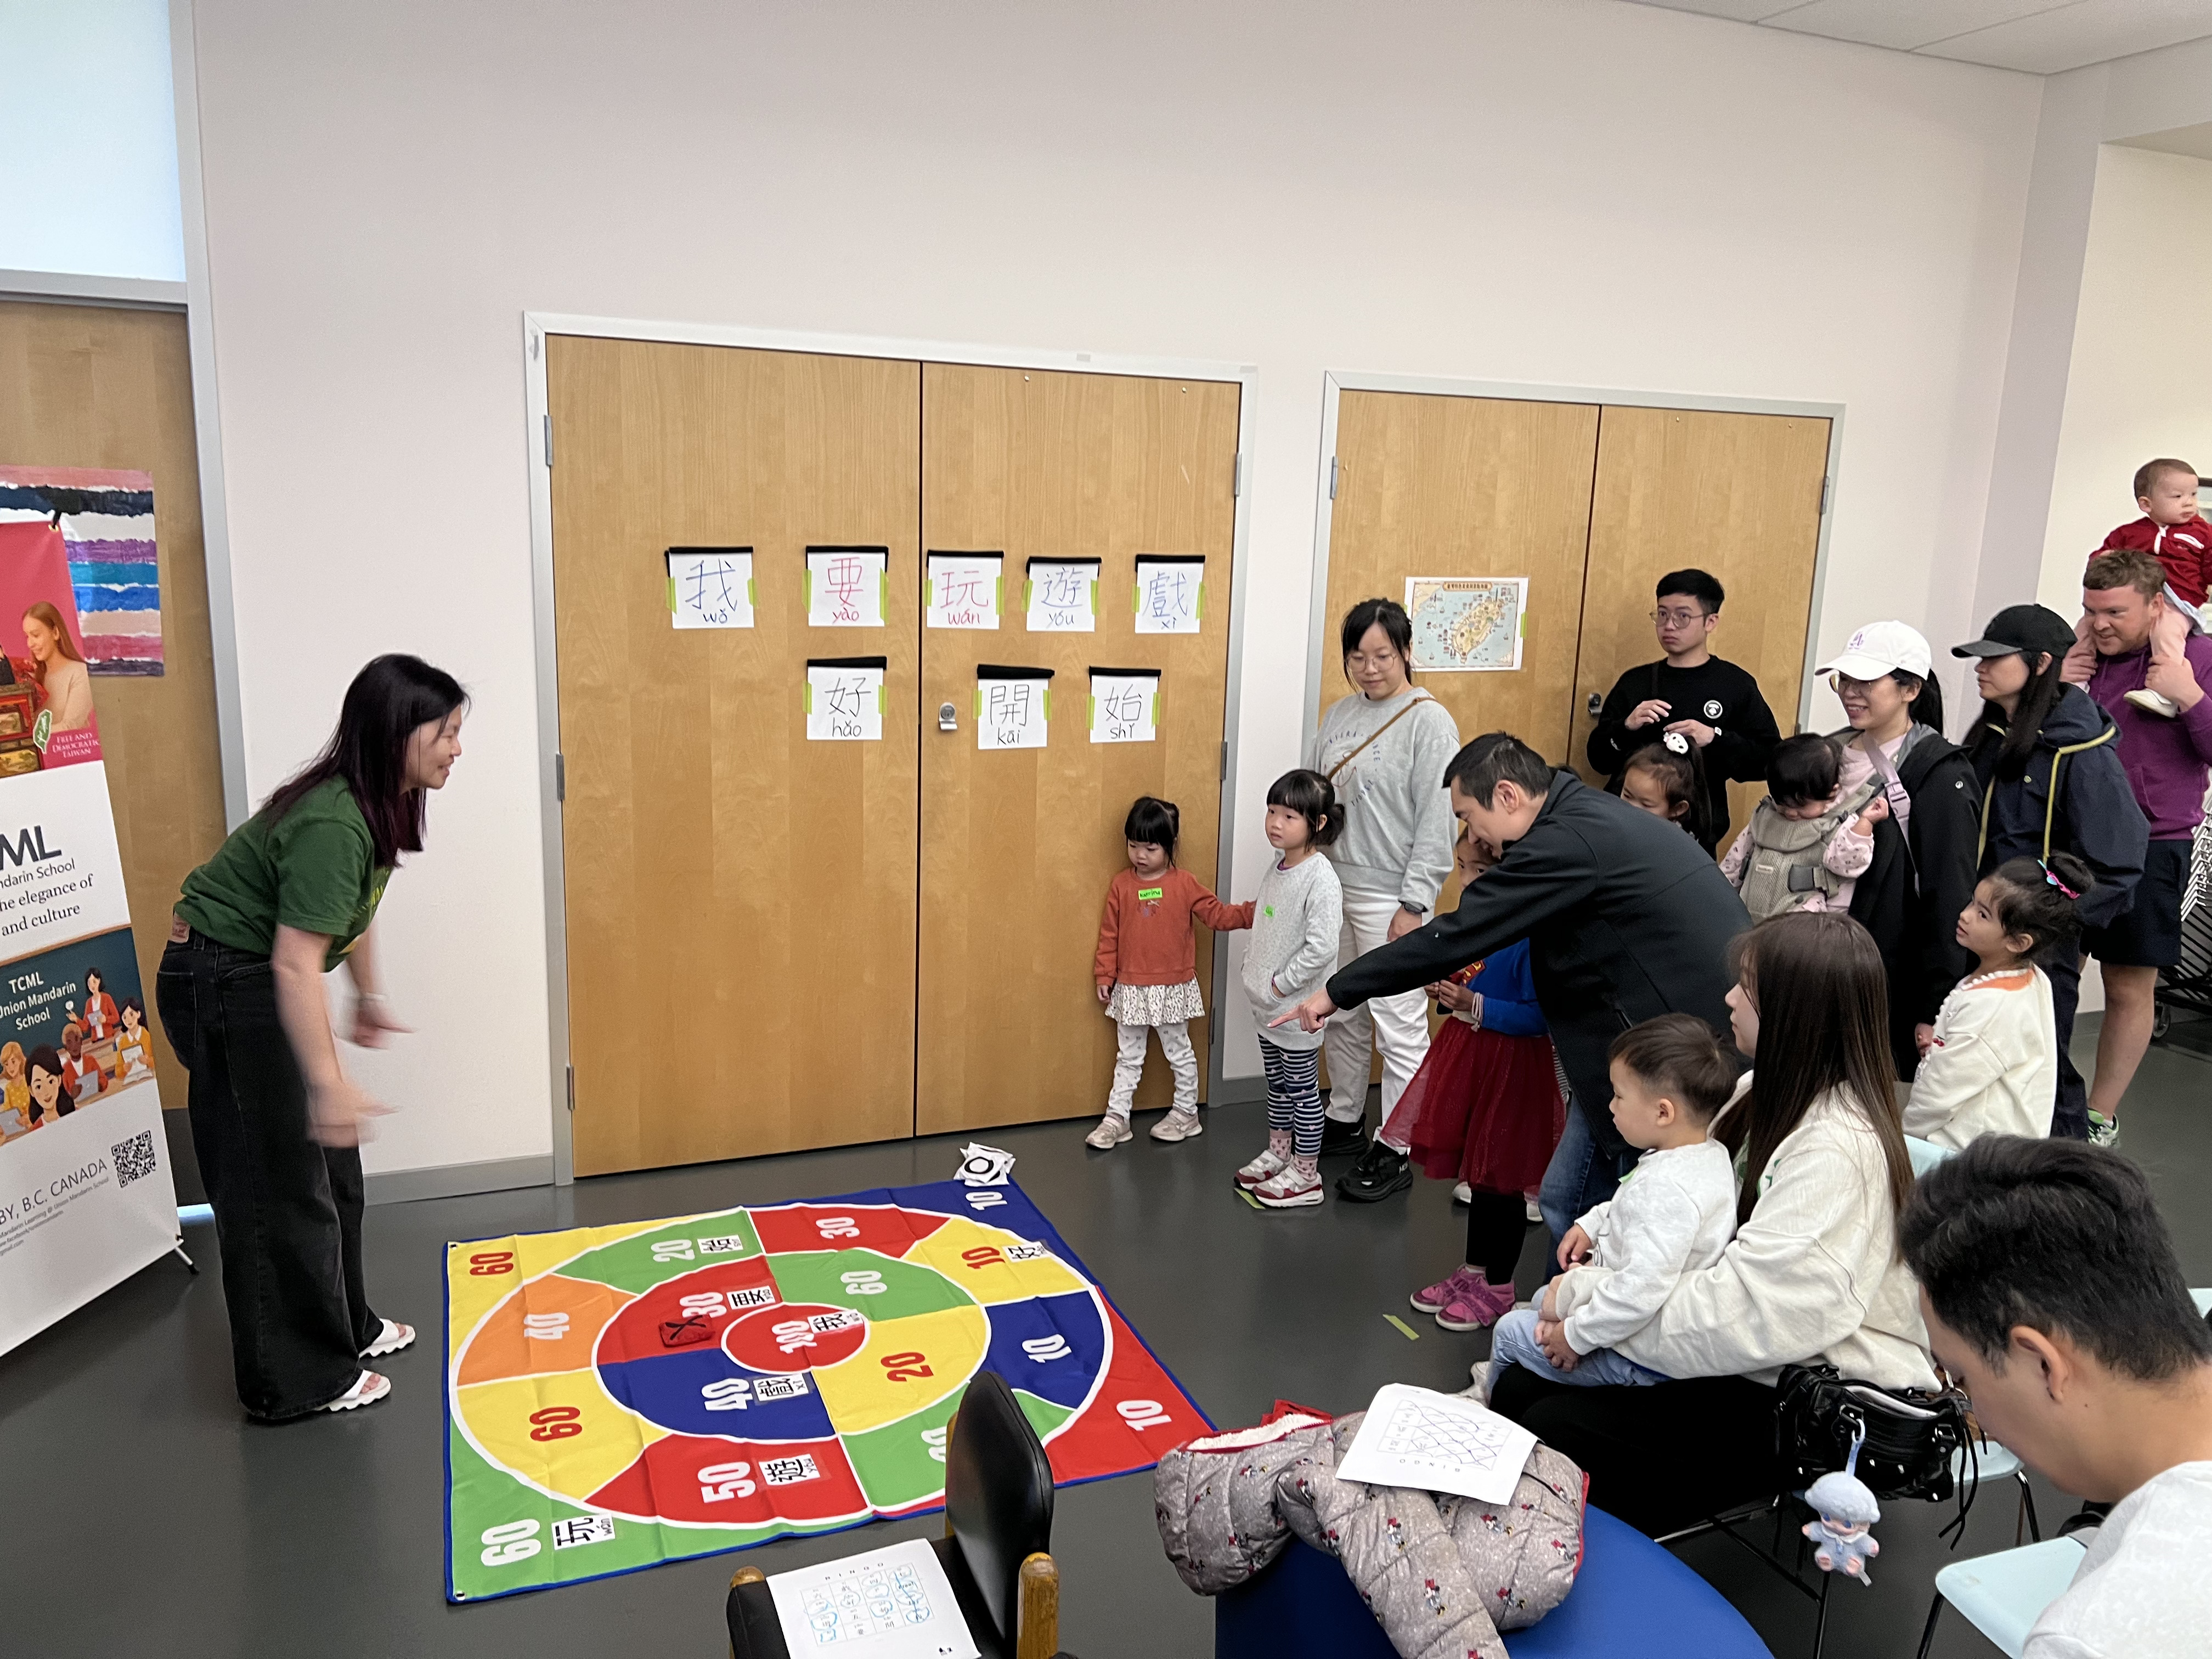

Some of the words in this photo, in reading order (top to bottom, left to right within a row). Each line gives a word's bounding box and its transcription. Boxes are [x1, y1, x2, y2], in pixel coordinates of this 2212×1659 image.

[685, 558, 736, 611] 我
[825, 557, 864, 607] 要
[940, 570, 989, 609] 玩
[1041, 567, 1083, 608] 遊
[1142, 571, 1188, 617] 戲
[825, 677, 872, 717] 好
[990, 684, 1030, 726] 開
[1104, 684, 1142, 721] 始
[63, 747, 91, 758] TAIWAN
[36, 857, 75, 878] School
[19, 883, 76, 904] elegance
[80, 873, 93, 888] of
[2, 916, 28, 936] and
[31, 905, 80, 927] culture
[8, 972, 44, 994] TCML
[27, 981, 76, 1008] Mandarin
[15, 1006, 50, 1030] School
[22, 1189, 48, 1212] B.C.
[50, 1159, 108, 1197] CANADA
[966, 1192, 1008, 1210] 10
[815, 1216, 860, 1239] 30
[469, 1251, 514, 1276] 60
[651, 1239, 695, 1262] 20
[962, 1246, 1006, 1269] 10
[1008, 1246, 1040, 1259] 好
[840, 1270, 887, 1294] 60
[680, 1292, 727, 1318] 30
[731, 1290, 765, 1306] 要
[523, 1312, 569, 1340] 40
[812, 1313, 842, 1331] 我
[771, 1321, 817, 1354] 100
[1022, 1334, 1072, 1363] 10
[881, 1352, 934, 1382] 20
[701, 1378, 753, 1410] 40
[529, 1406, 583, 1442] 60
[1116, 1400, 1172, 1431] 10
[697, 1461, 756, 1503] 50
[764, 1459, 807, 1482] 遊
[481, 1519, 541, 1566] 60
[555, 1517, 595, 1546] 玩
